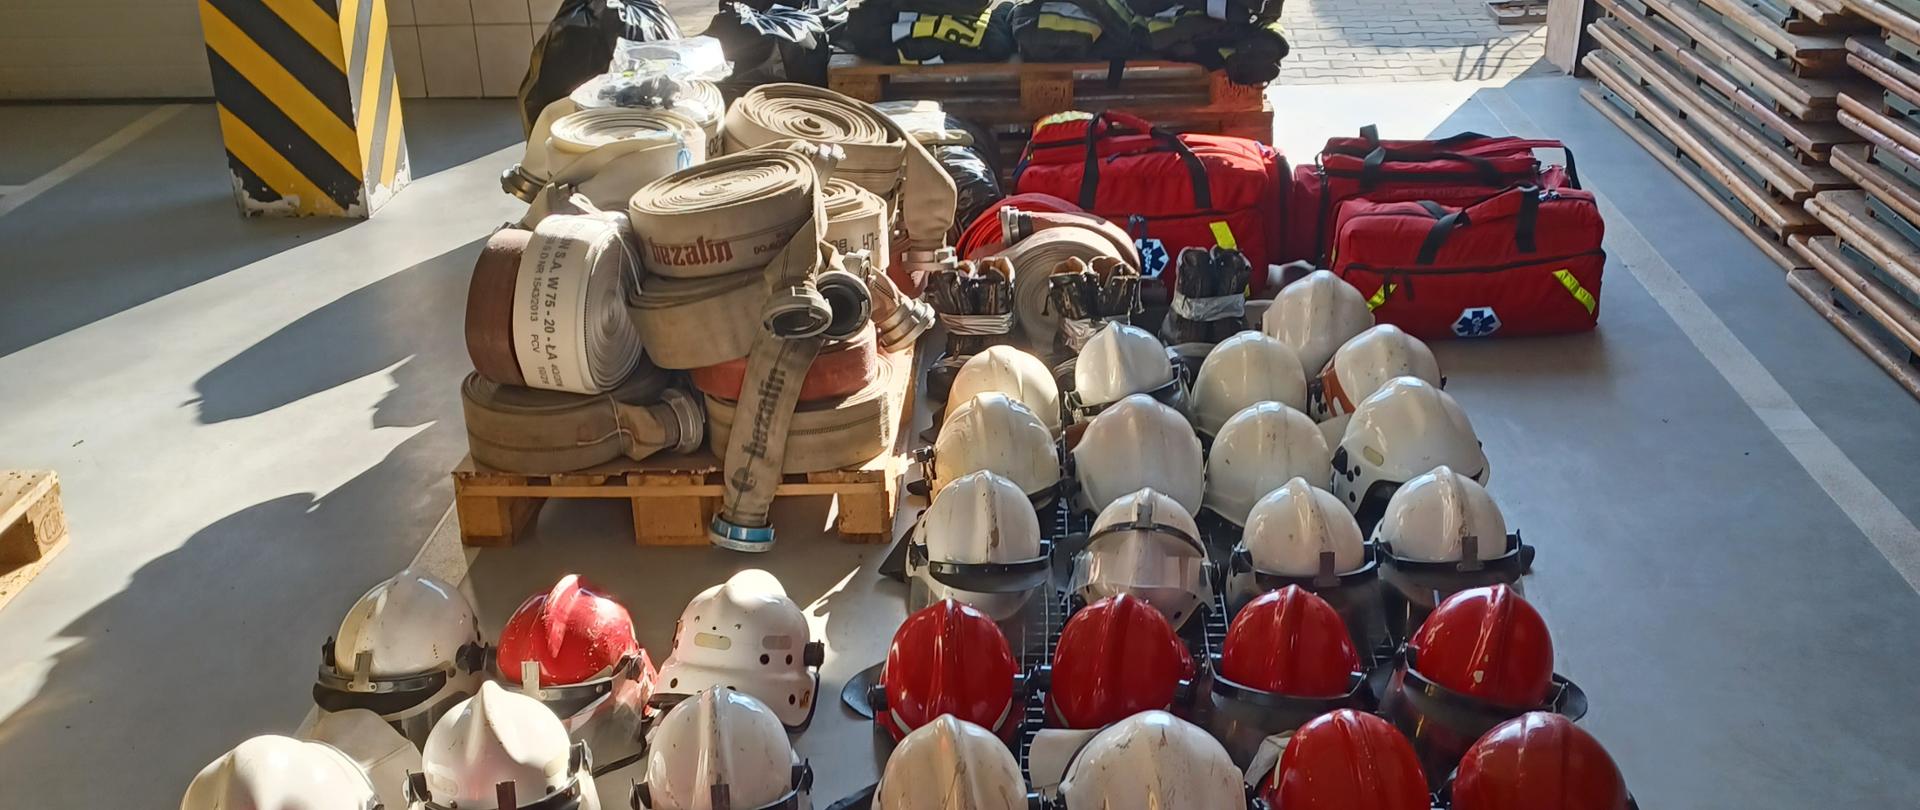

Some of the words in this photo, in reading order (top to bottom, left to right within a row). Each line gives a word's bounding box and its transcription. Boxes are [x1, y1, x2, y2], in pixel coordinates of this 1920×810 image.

[546, 276, 560, 290] W
[545, 293, 557, 308] 75
[543, 318, 556, 334] 20
